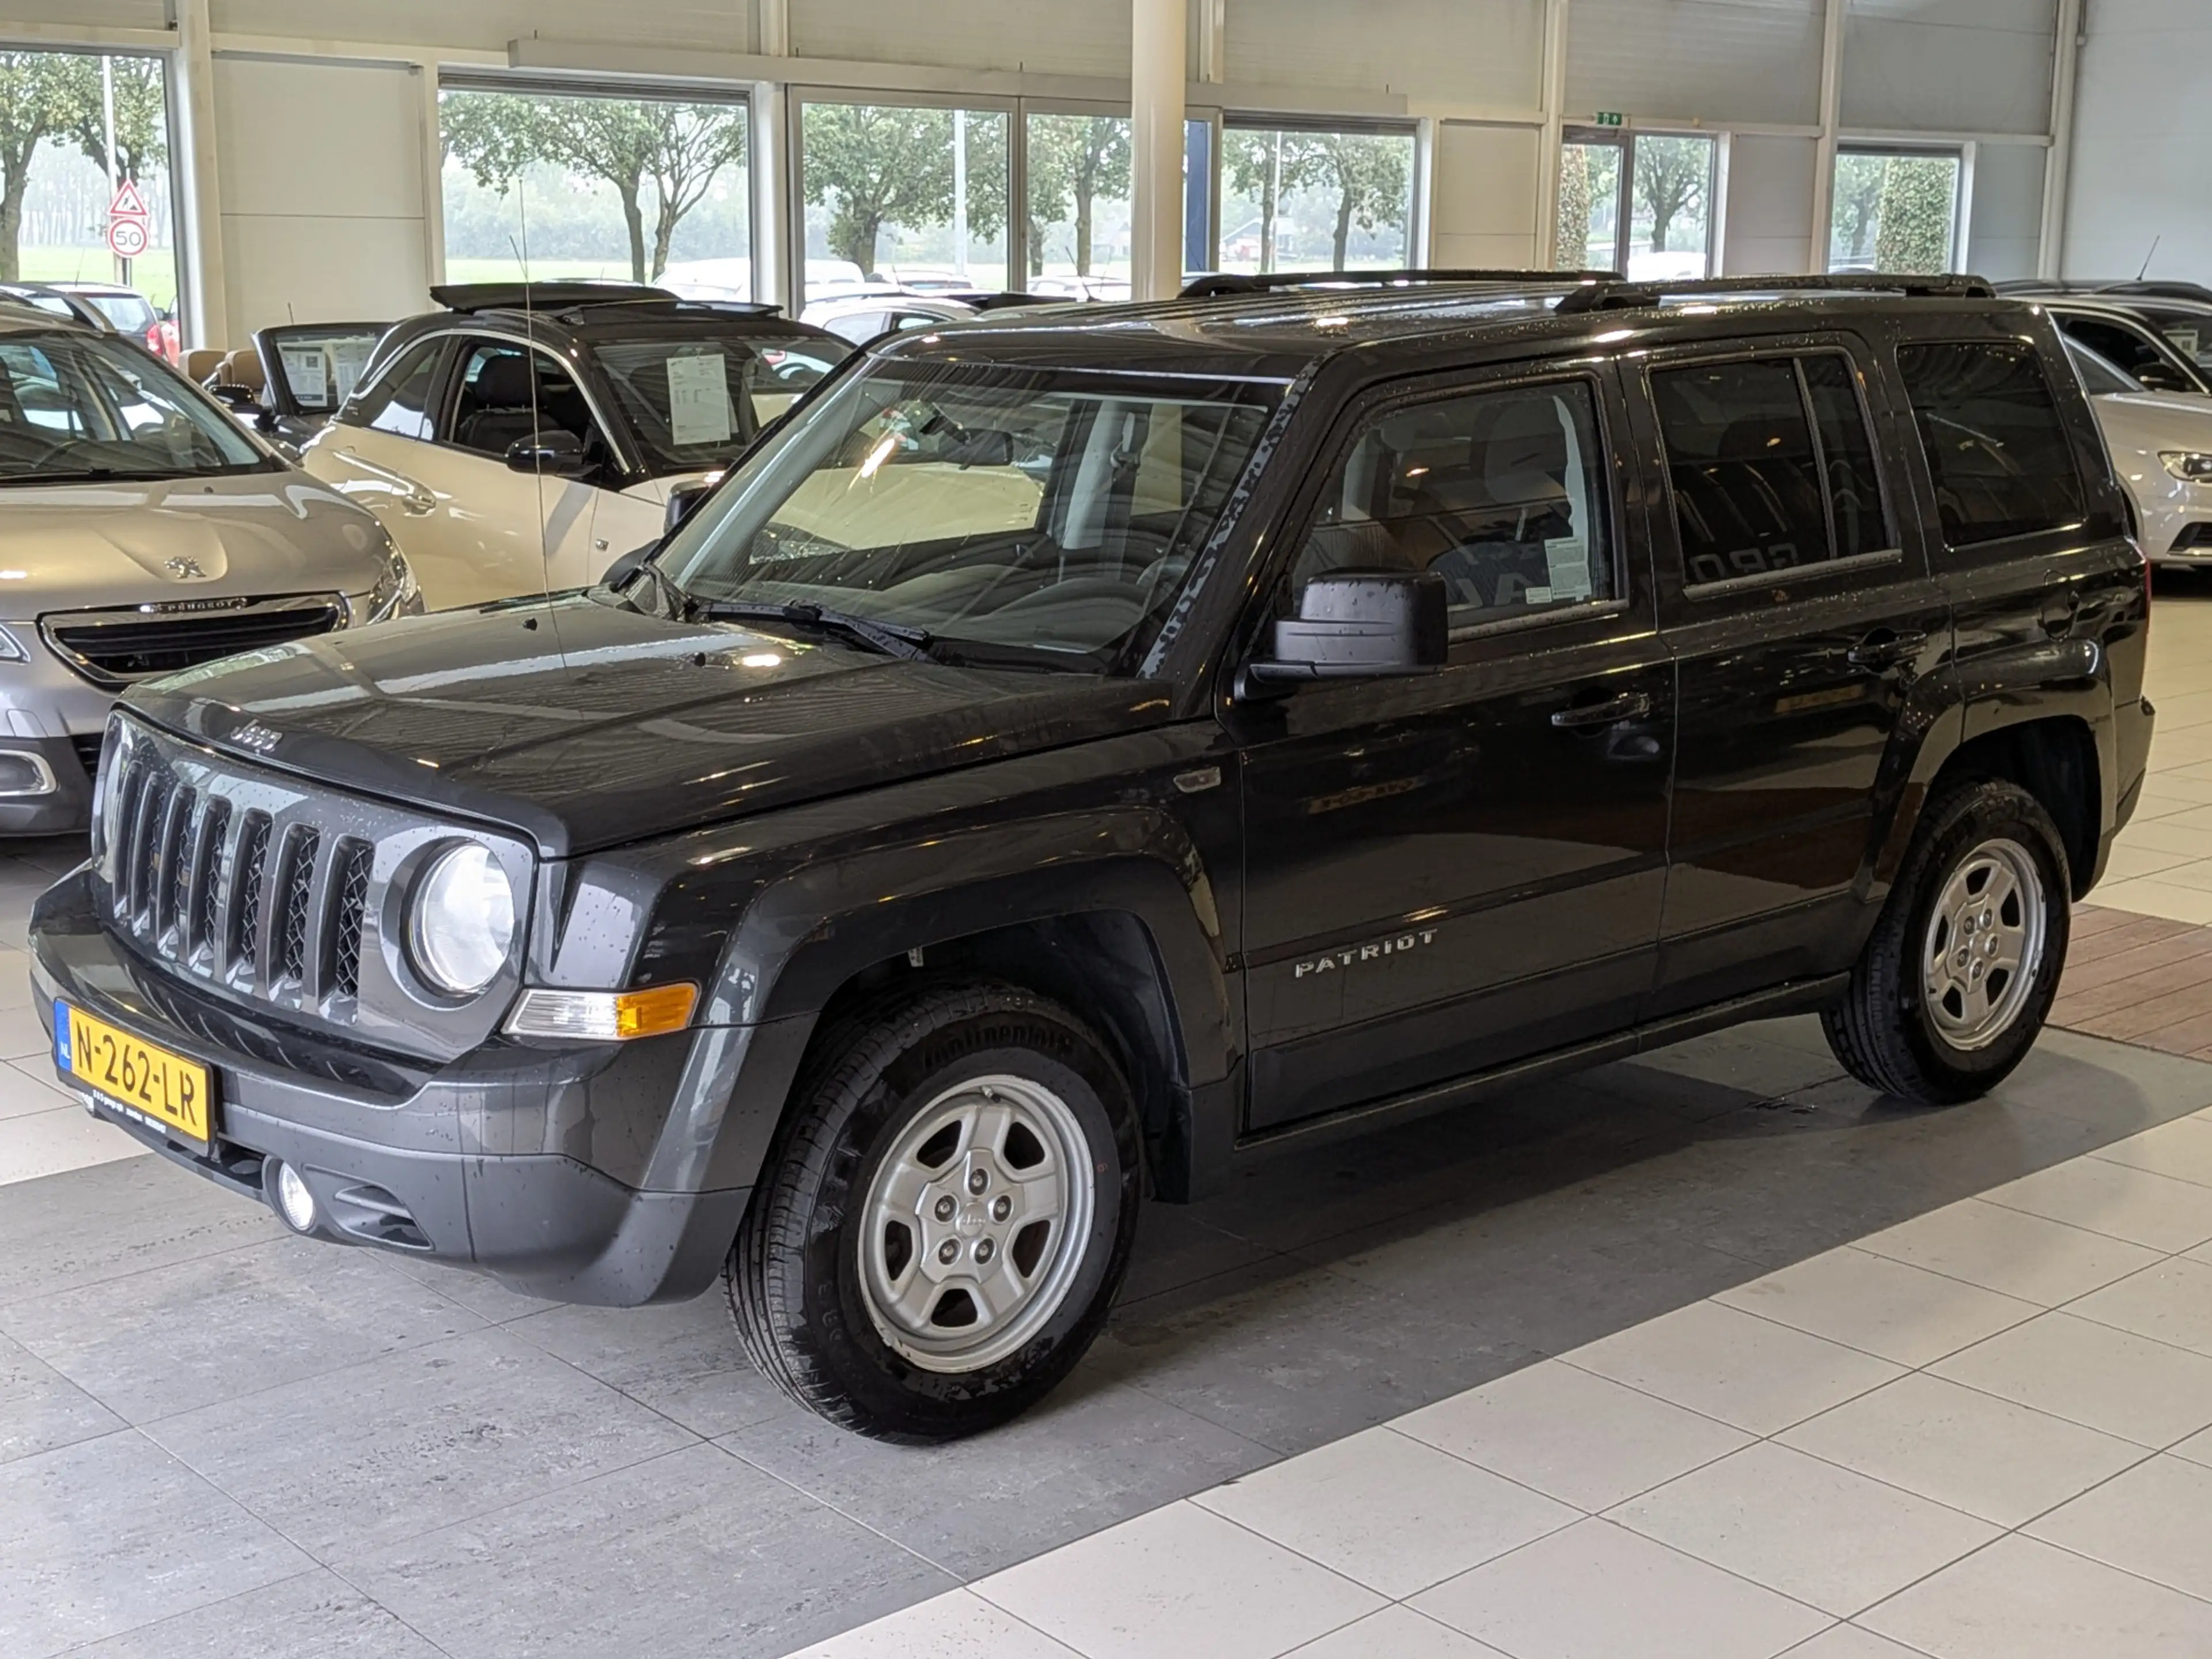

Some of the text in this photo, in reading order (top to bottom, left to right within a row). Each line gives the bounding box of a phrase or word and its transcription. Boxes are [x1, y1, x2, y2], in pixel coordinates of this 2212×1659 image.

[116, 231, 141, 246] 50
[168, 601, 233, 611] PEUGEOT
[231, 719, 282, 752] Jeep
[1295, 929, 1438, 978] PATRIOT
[76, 1021, 197, 1126] N-262-LR
